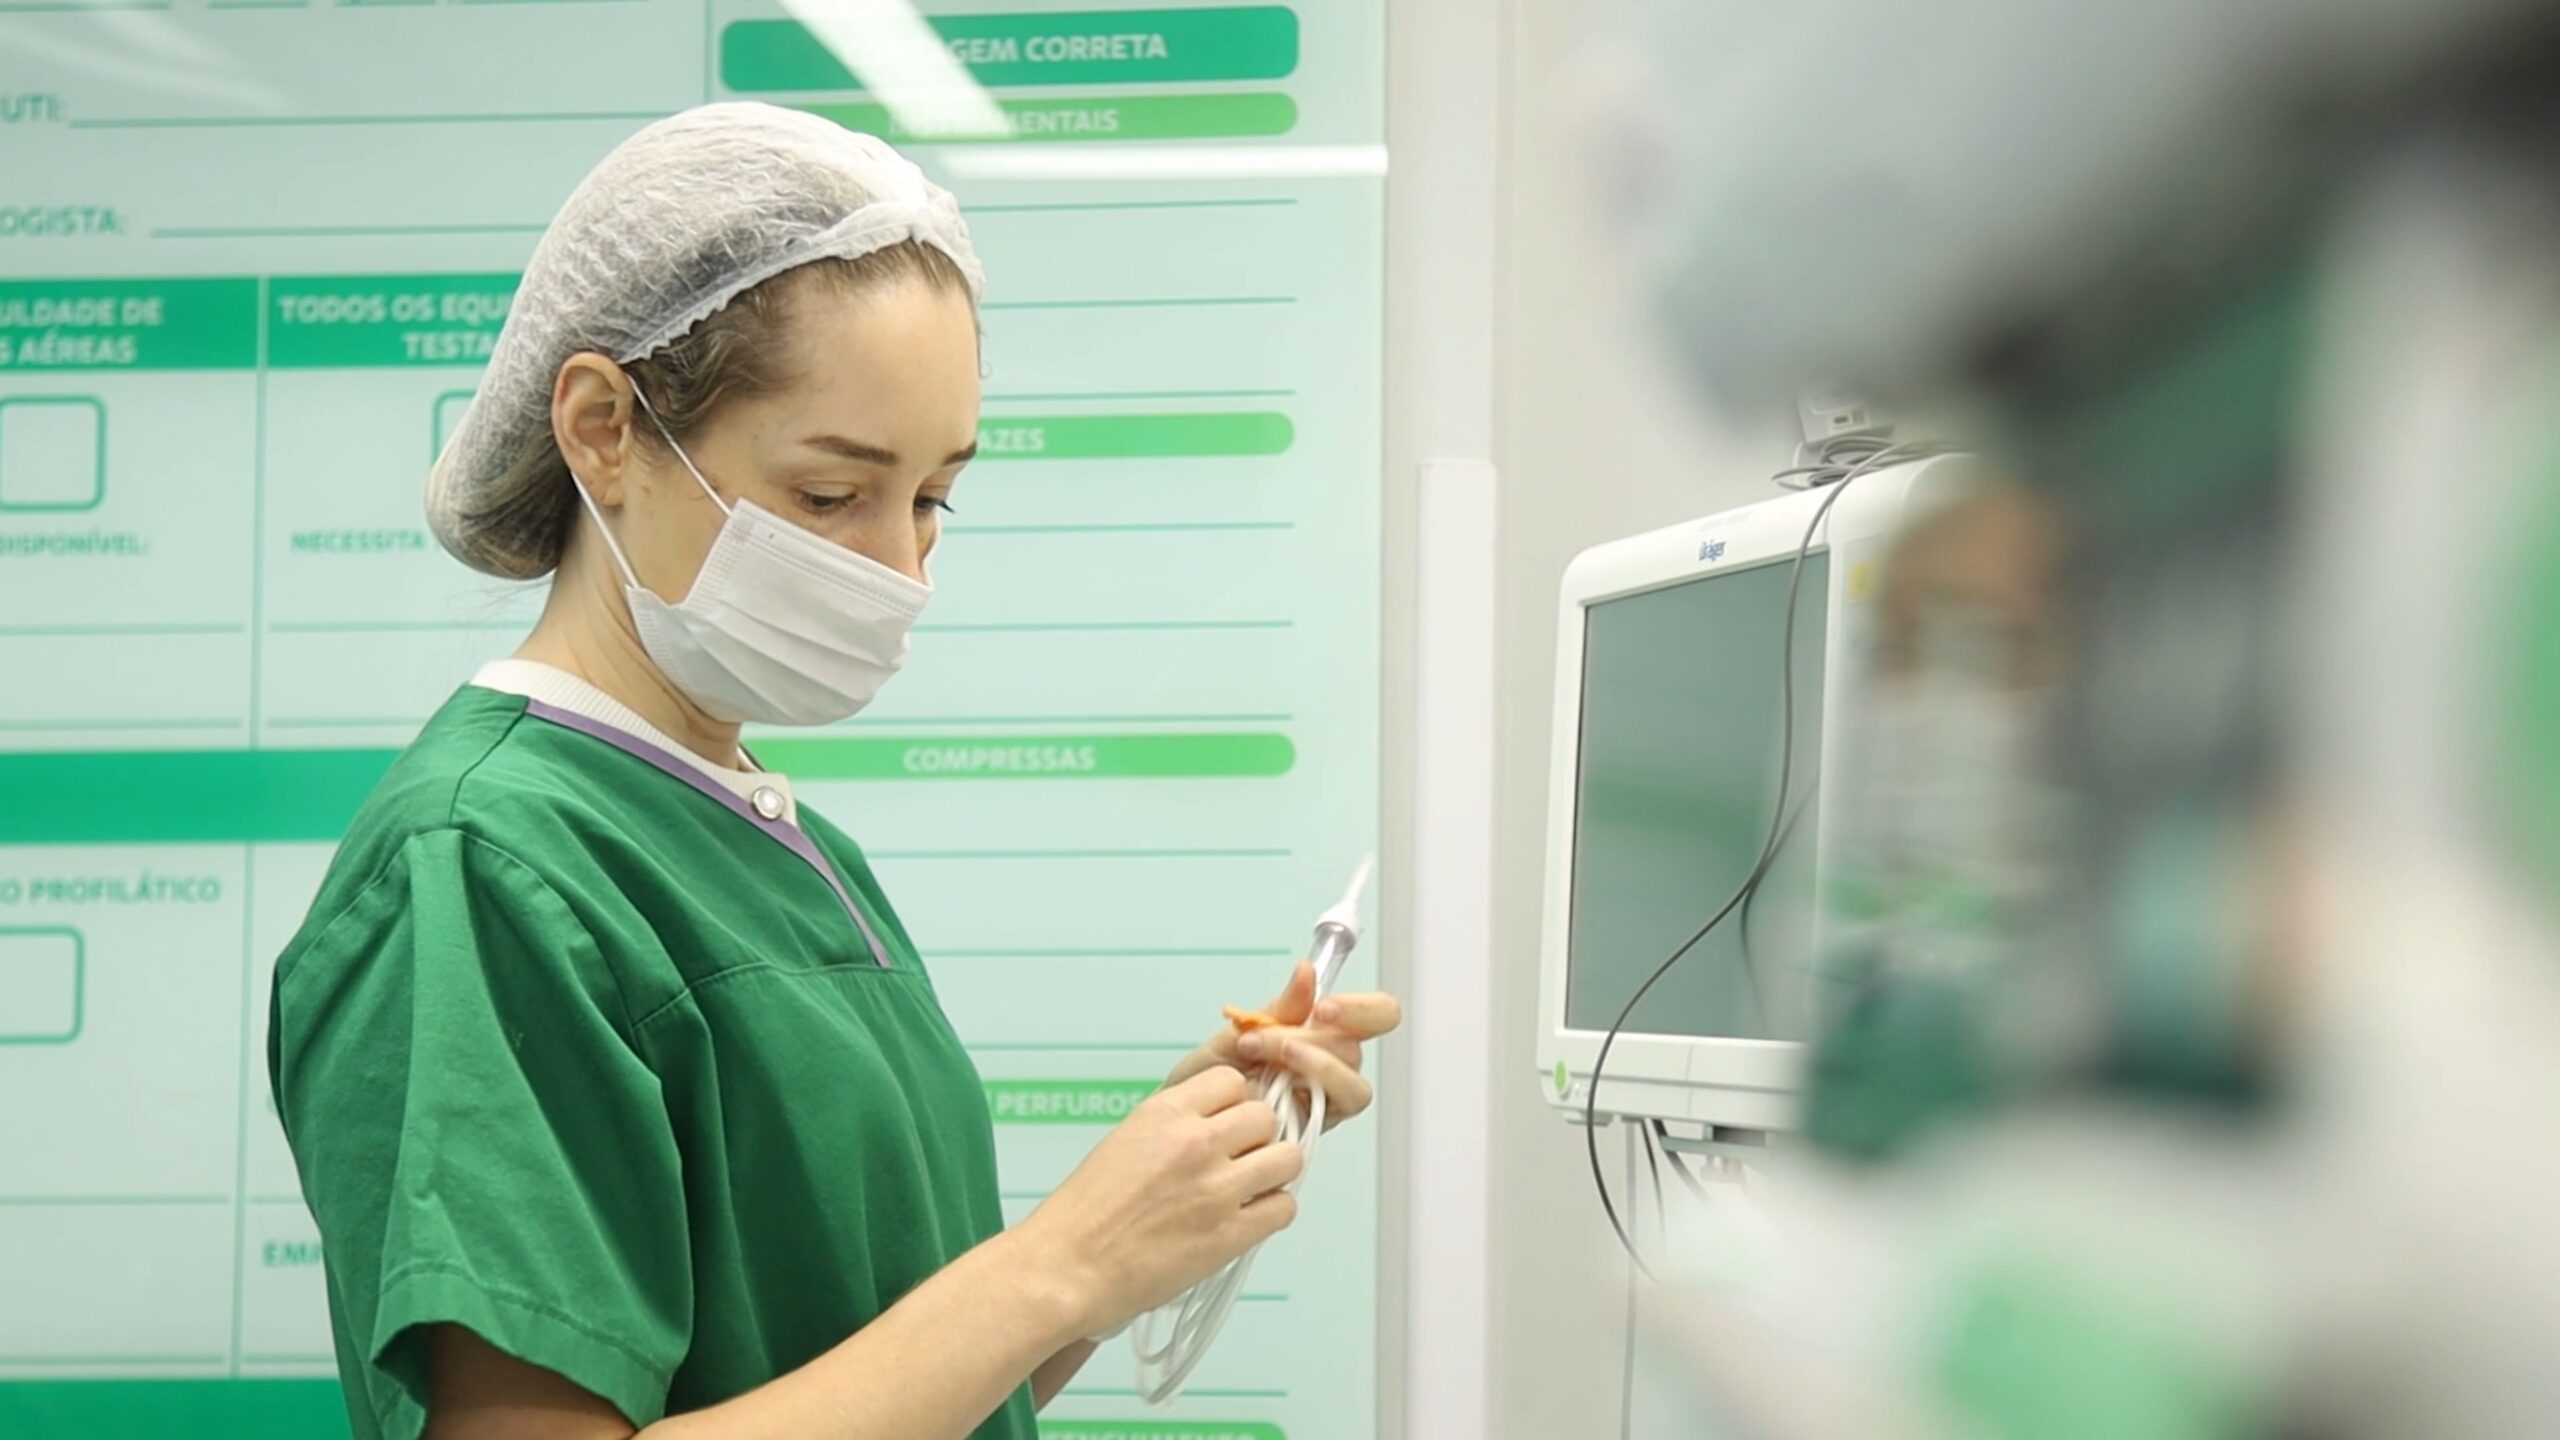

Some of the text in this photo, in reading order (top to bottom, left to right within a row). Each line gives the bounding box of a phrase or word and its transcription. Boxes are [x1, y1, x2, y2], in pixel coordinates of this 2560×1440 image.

[1025, 34, 1168, 62] CORRETA
[121, 297, 163, 326] DE
[279, 295, 386, 323] TODOS
[391, 294, 436, 322] OS
[18, 327, 136, 364] AÉREAS
[292, 530, 424, 552] NECESSITA
[902, 747, 1096, 771] COMPRESSAS
[31, 869, 221, 903] PROFILÁTICO
